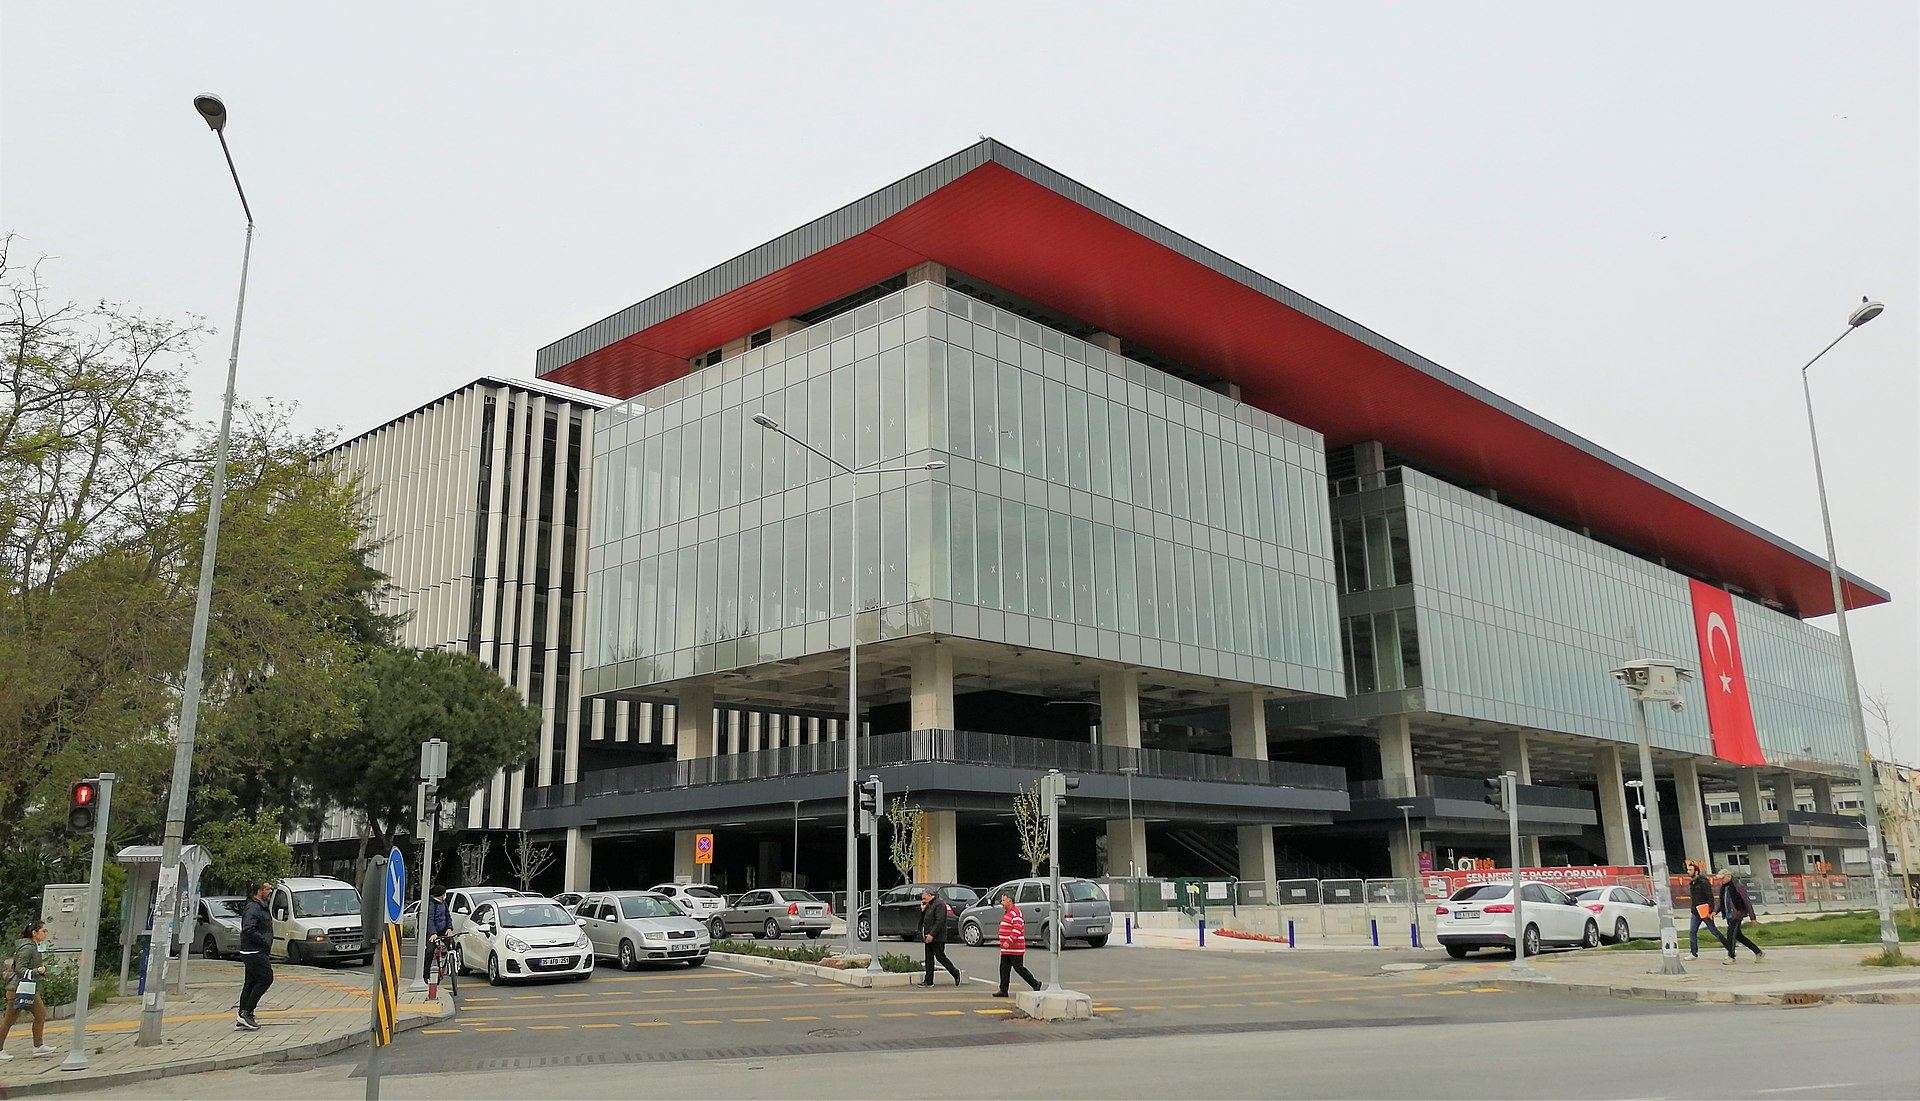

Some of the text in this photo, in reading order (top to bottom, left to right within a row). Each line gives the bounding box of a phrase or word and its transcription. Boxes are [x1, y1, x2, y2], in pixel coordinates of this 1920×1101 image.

[1466, 872, 1487, 883] SEN
[1487, 871, 1527, 881] NEREE
[1564, 868, 1607, 879] ORADA!
